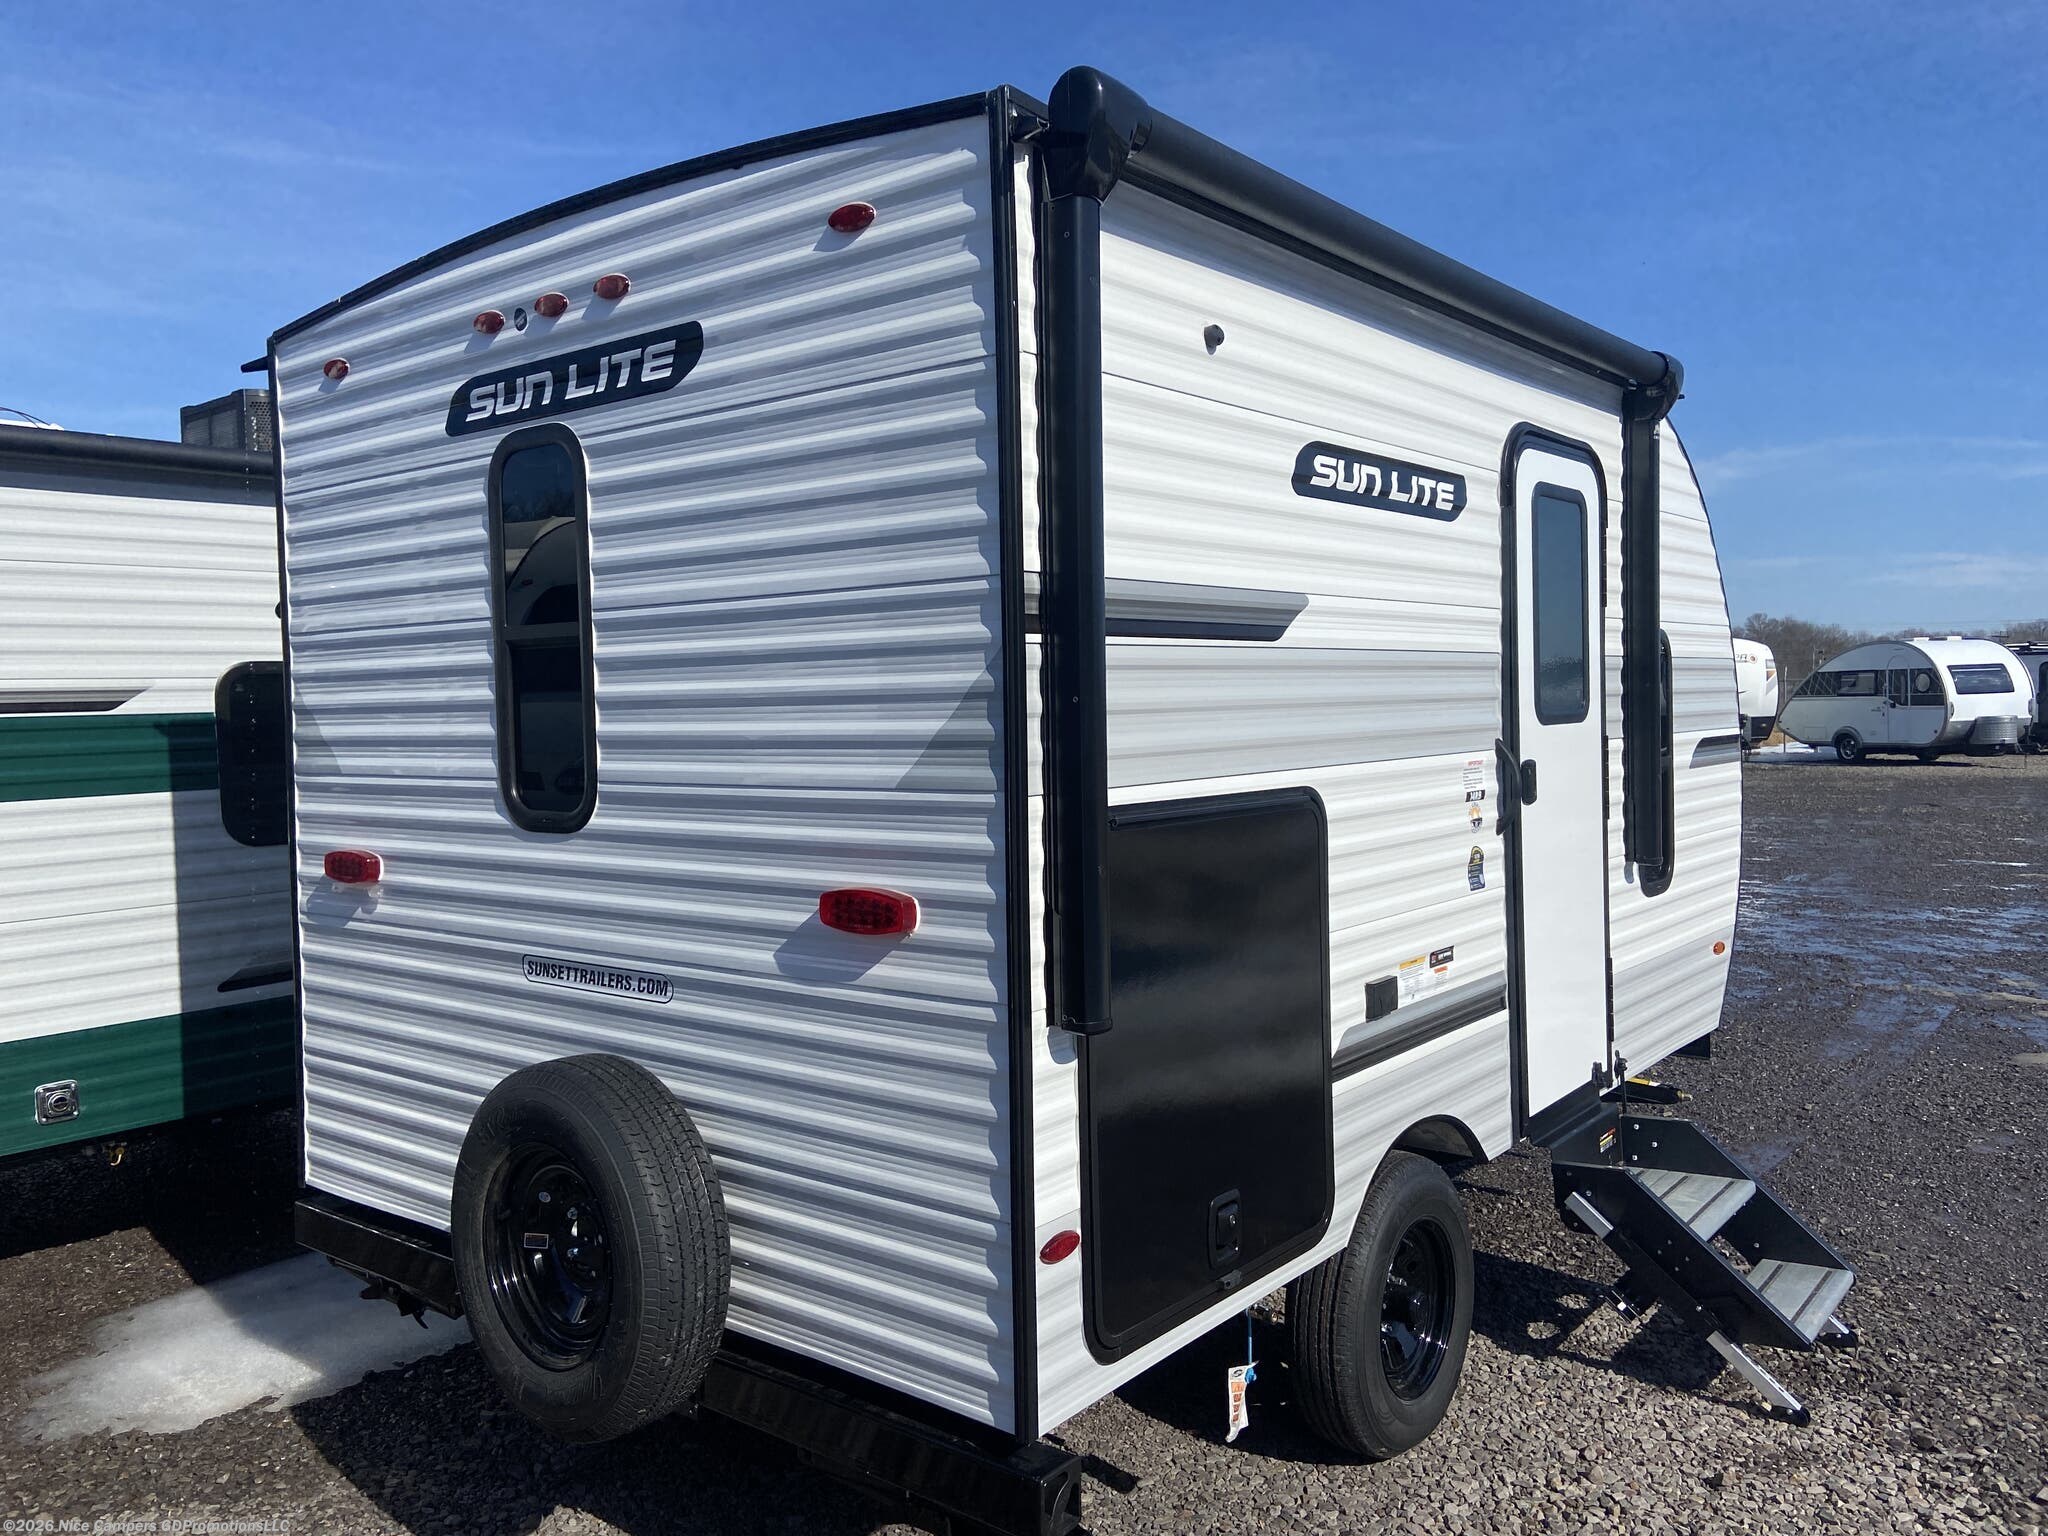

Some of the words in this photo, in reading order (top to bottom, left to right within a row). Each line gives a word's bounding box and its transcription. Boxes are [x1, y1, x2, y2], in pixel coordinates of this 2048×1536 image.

[465, 370, 553, 422] SUN
[565, 339, 676, 400] LITE
[1310, 454, 1382, 497] SUN
[1388, 470, 1455, 511] LITE
[527, 960, 668, 997] SUNSETTRAILERS.COM
